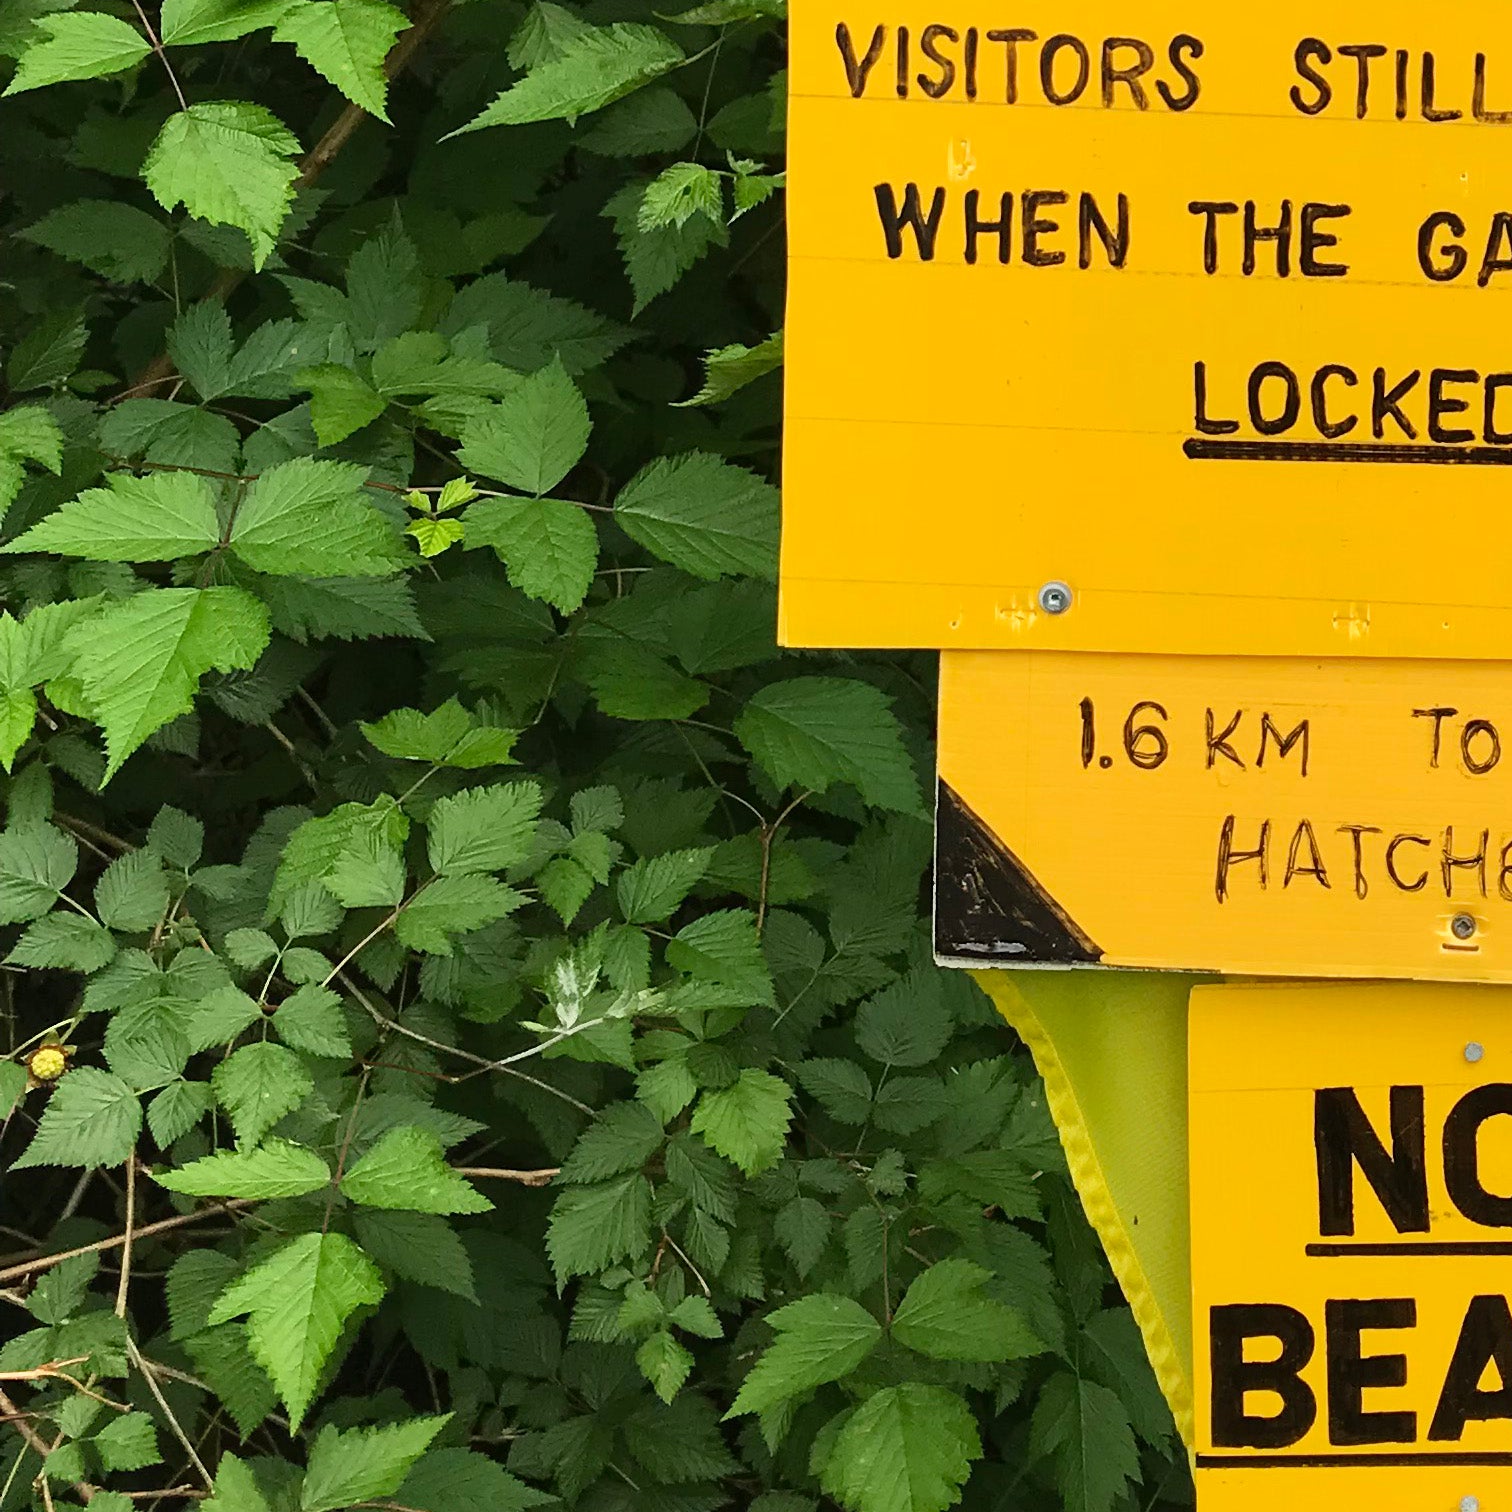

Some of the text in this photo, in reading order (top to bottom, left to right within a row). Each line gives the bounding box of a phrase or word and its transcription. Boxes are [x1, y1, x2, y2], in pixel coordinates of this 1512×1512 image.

[836, 23, 1203, 112] VISITORS
[874, 183, 1129, 269] WHEN
[1188, 200, 1351, 278] THE
[1079, 697, 1167, 769] 1.6
[1206, 708, 1308, 777] KM
[1412, 708, 1500, 774] TO
